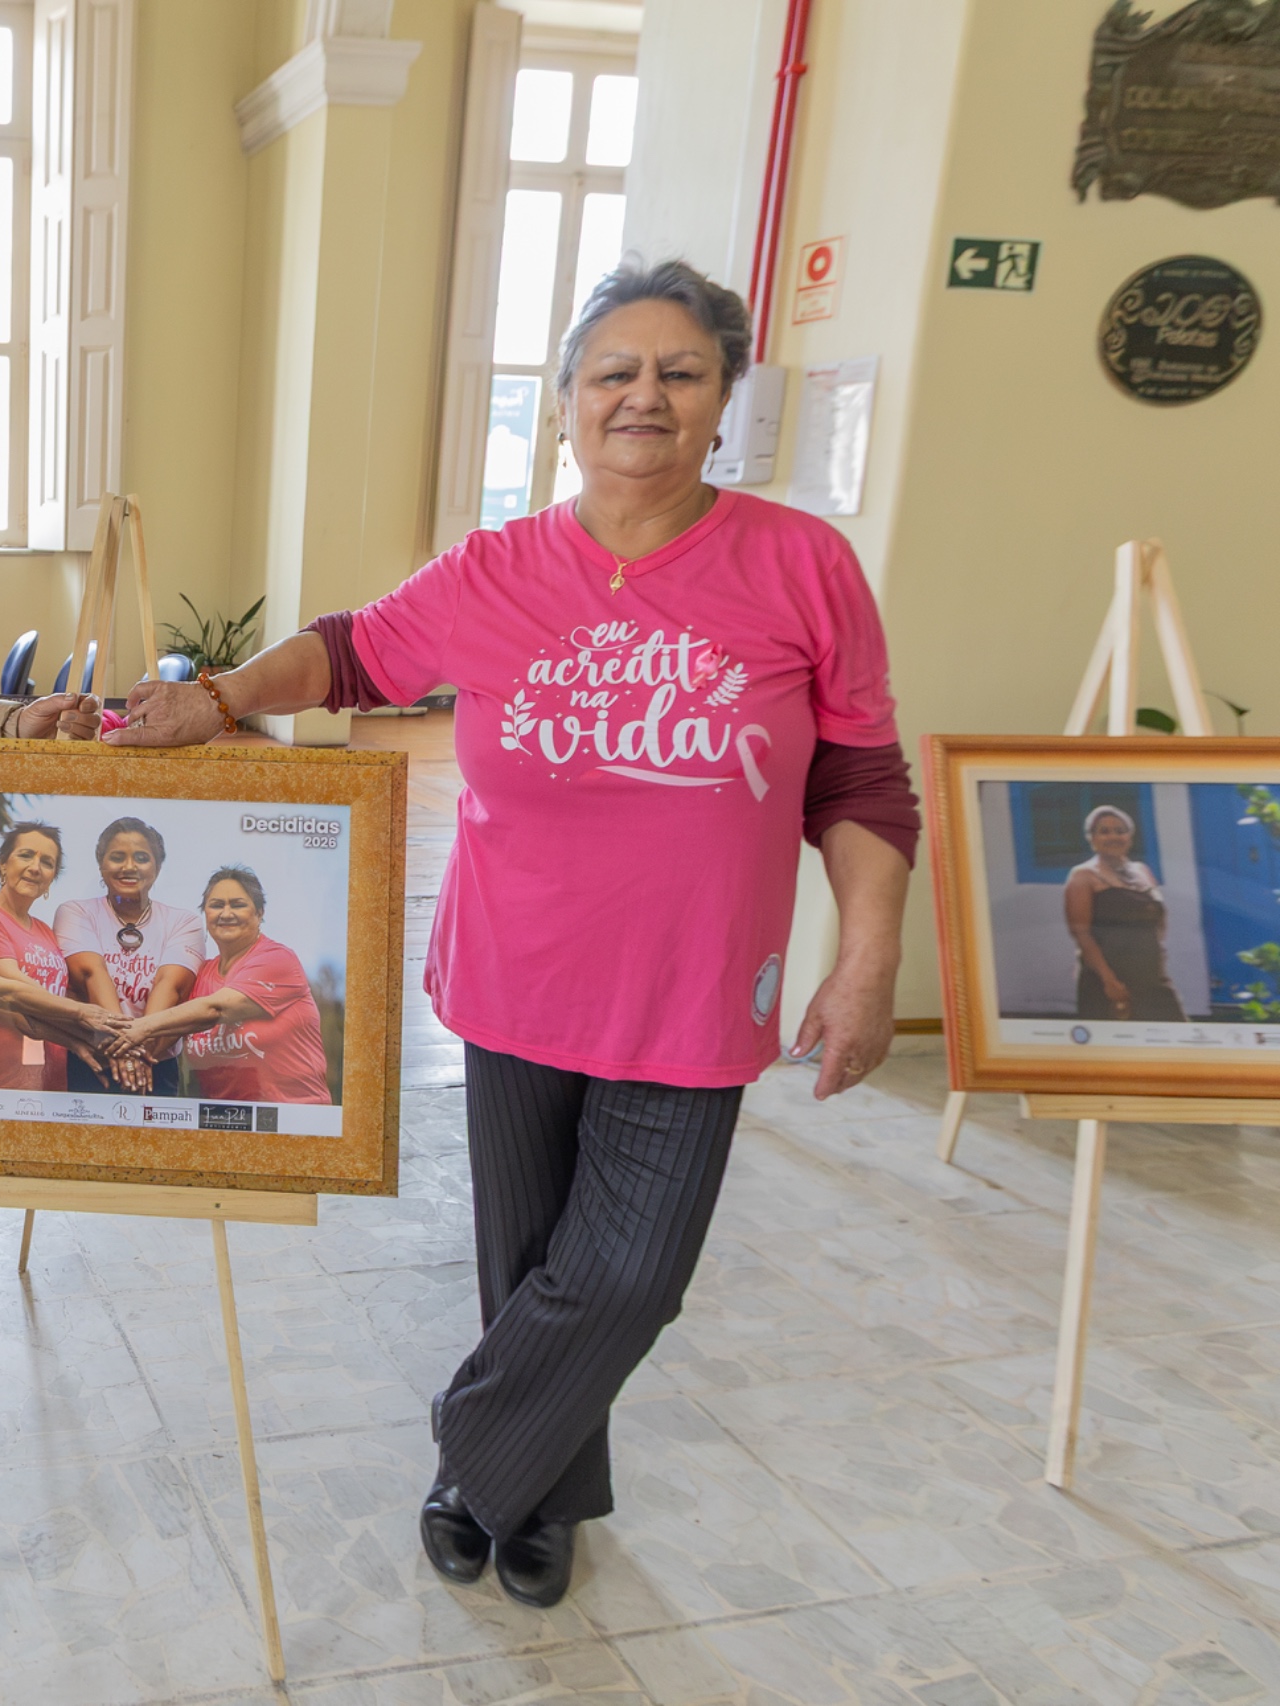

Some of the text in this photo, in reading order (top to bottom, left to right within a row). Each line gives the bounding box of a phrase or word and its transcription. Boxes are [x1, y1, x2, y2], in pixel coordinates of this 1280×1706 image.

[578, 620, 640, 650] eu
[527, 629, 716, 694] acredit
[570, 689, 619, 709] na
[538, 683, 732, 768] vida
[242, 815, 340, 834] Decididas
[303, 836, 338, 849] 2026
[144, 1107, 193, 1123] Pampah
